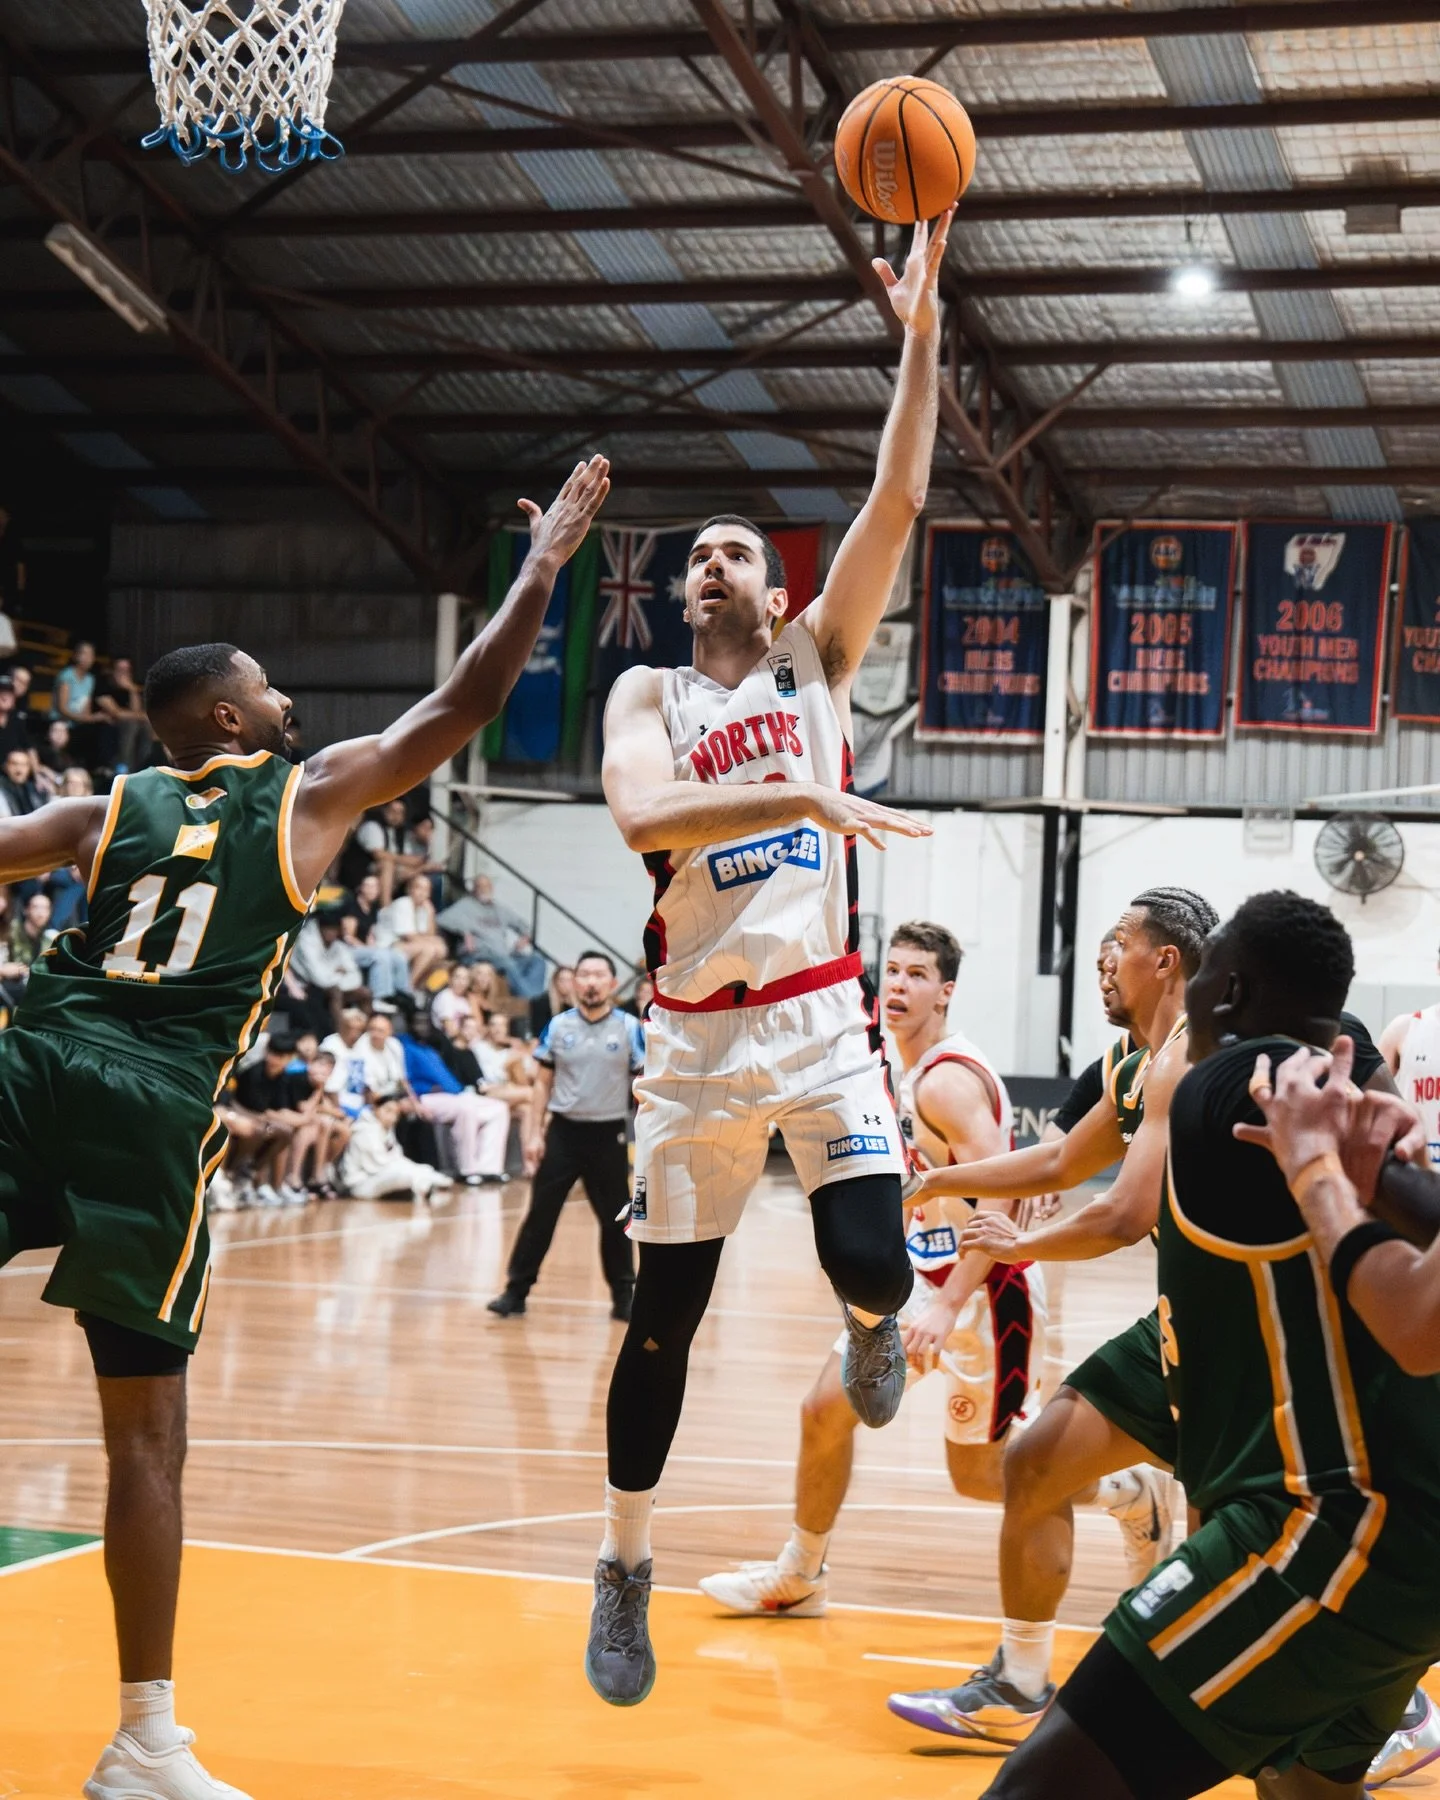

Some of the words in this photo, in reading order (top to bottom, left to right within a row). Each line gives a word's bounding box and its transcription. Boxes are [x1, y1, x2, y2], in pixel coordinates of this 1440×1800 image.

[1130, 612, 1192, 645] 2005
[1276, 600, 1344, 631] 2006
[1257, 634, 1315, 657] YOUTH
[1253, 658, 1359, 684] CHAMPIONS
[690, 711, 803, 785] NORTHS
[715, 841, 789, 883] BING
[788, 833, 820, 862] LEE
[101, 874, 218, 975] 11
[829, 1137, 863, 1156] BING
[863, 1137, 887, 1151] LEE
